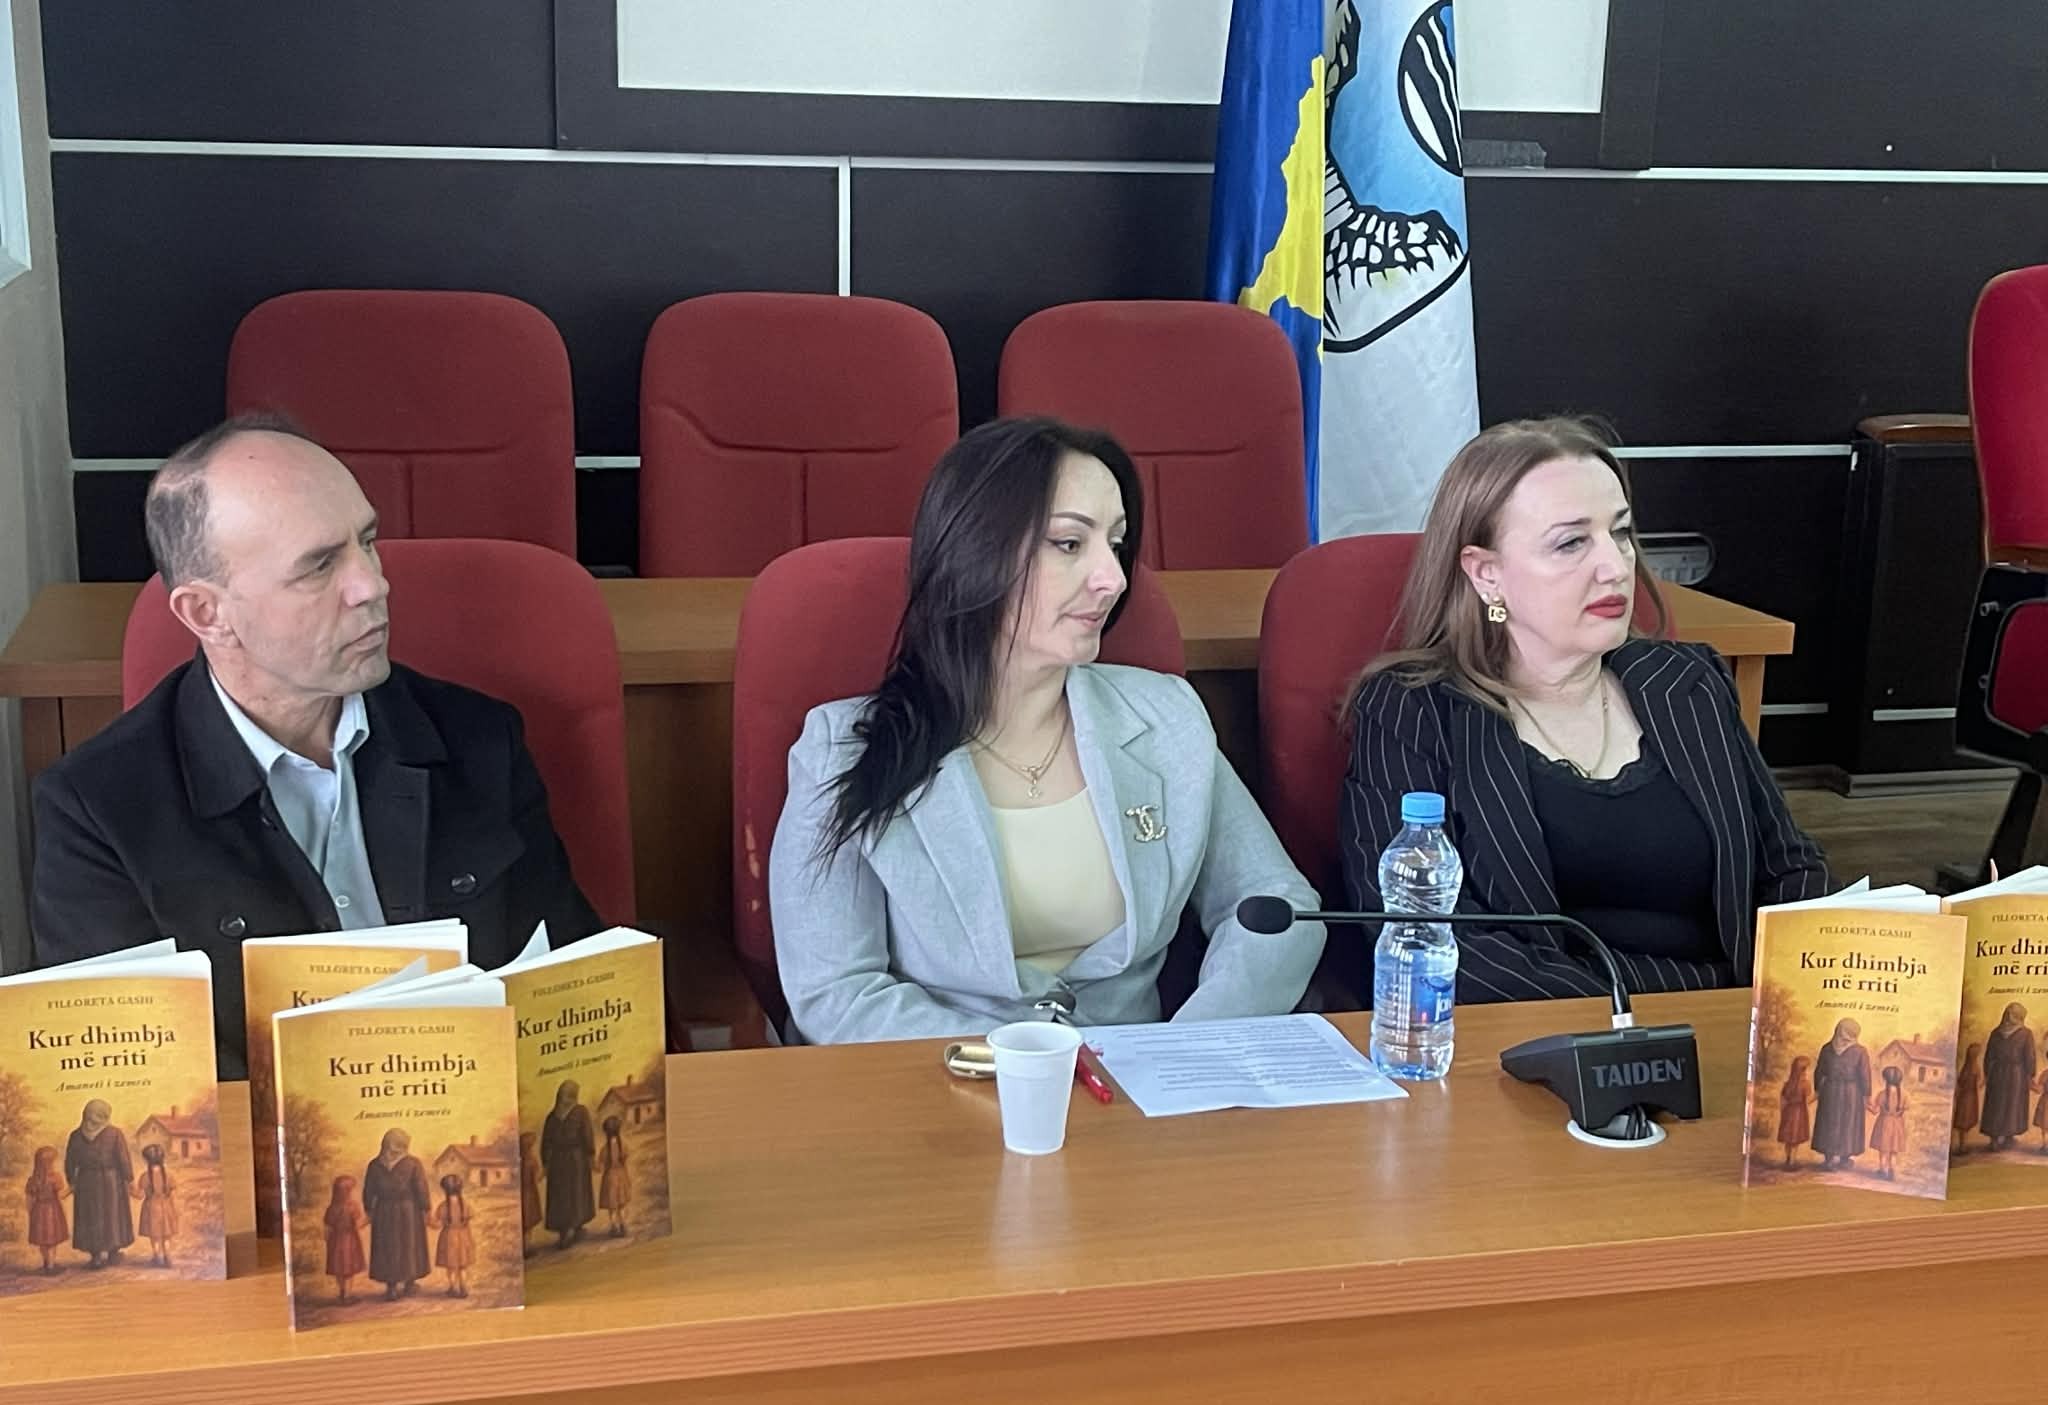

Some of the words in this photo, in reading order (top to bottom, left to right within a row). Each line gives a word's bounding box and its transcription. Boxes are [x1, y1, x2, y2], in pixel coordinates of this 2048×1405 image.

[1820, 926, 1876, 936] FILLORETA
[1879, 928, 1912, 938] GASHI
[1976, 940, 2007, 958] Kur
[1801, 951, 1837, 968] Kur
[1842, 951, 1927, 979] dhimbja
[1993, 960, 2020, 975] më
[1822, 974, 1852, 989] më
[1857, 977, 1898, 993] rriti
[48, 997, 115, 1009] FILLORETA
[117, 996, 153, 1005] GASHI
[1815, 1000, 1857, 1009] Amaneti
[516, 1017, 553, 1039] Kur
[556, 997, 632, 1029] dhimbja
[28, 1029, 75, 1050] Kur
[80, 1024, 176, 1048] dhimbja
[348, 1026, 416, 1037] FILLORETA
[418, 1025, 455, 1035] GASHI
[540, 1034, 567, 1056] më
[573, 1024, 608, 1048] rriti
[60, 1051, 95, 1070] më
[102, 1049, 147, 1067] rriti
[329, 1057, 375, 1077] Kur
[381, 1053, 477, 1078] dhimbja
[1591, 1057, 1683, 1089] TAIDEN
[55, 1080, 104, 1092] Amaneti
[360, 1080, 396, 1099] më
[401, 1078, 447, 1097] rriti
[354, 1109, 402, 1121] Amaneti
